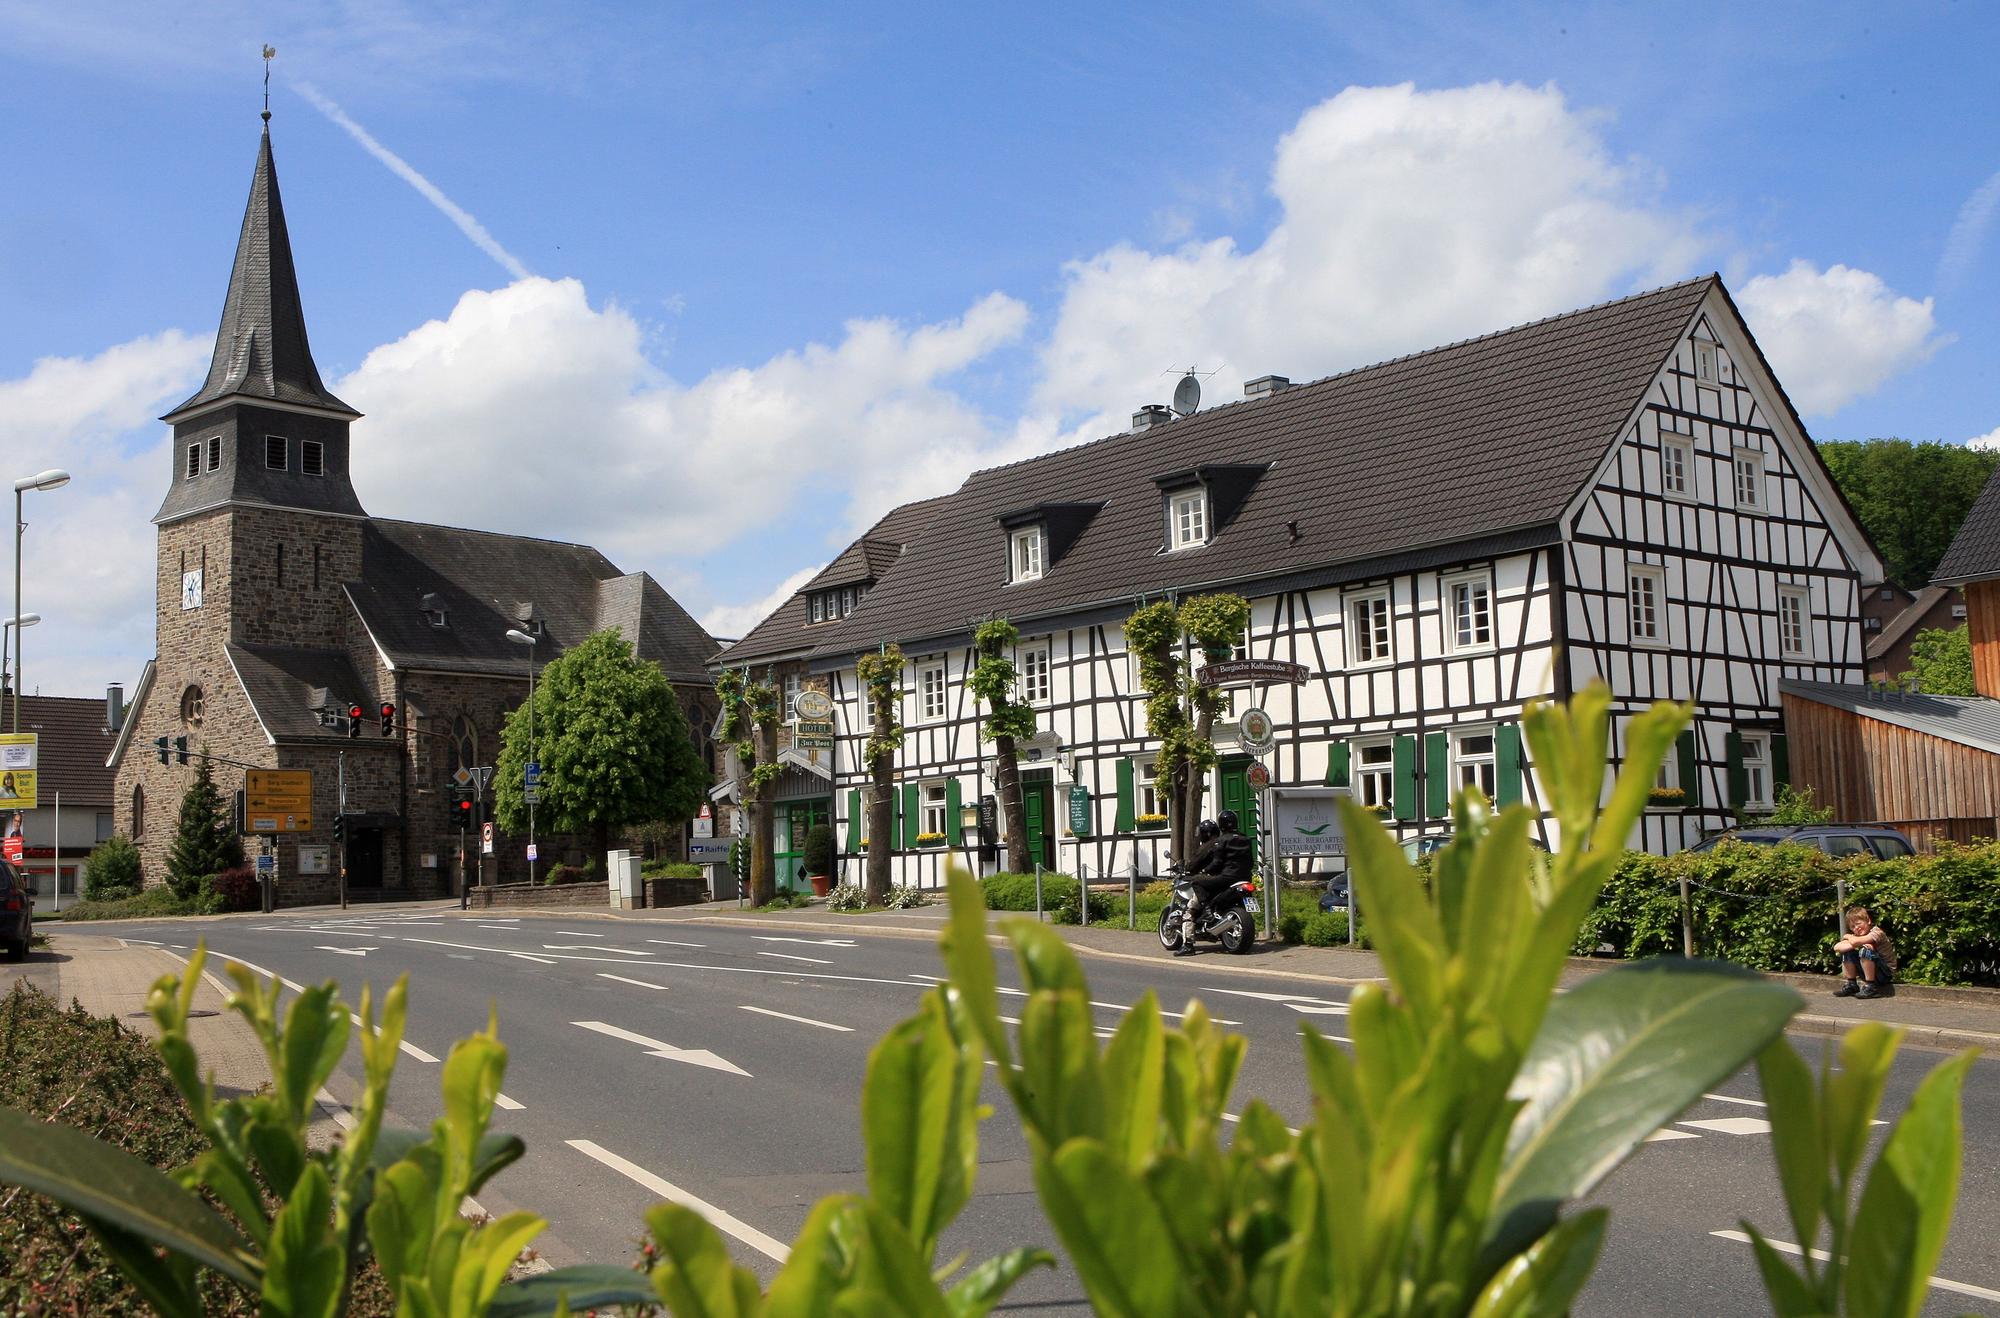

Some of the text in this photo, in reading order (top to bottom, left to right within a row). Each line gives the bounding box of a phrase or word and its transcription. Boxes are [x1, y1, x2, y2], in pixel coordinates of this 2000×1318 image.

[1220, 662, 1286, 673] Bergische Kaffeestube
[802, 724, 828, 732] HOTEL
[527, 764, 535, 774] P
